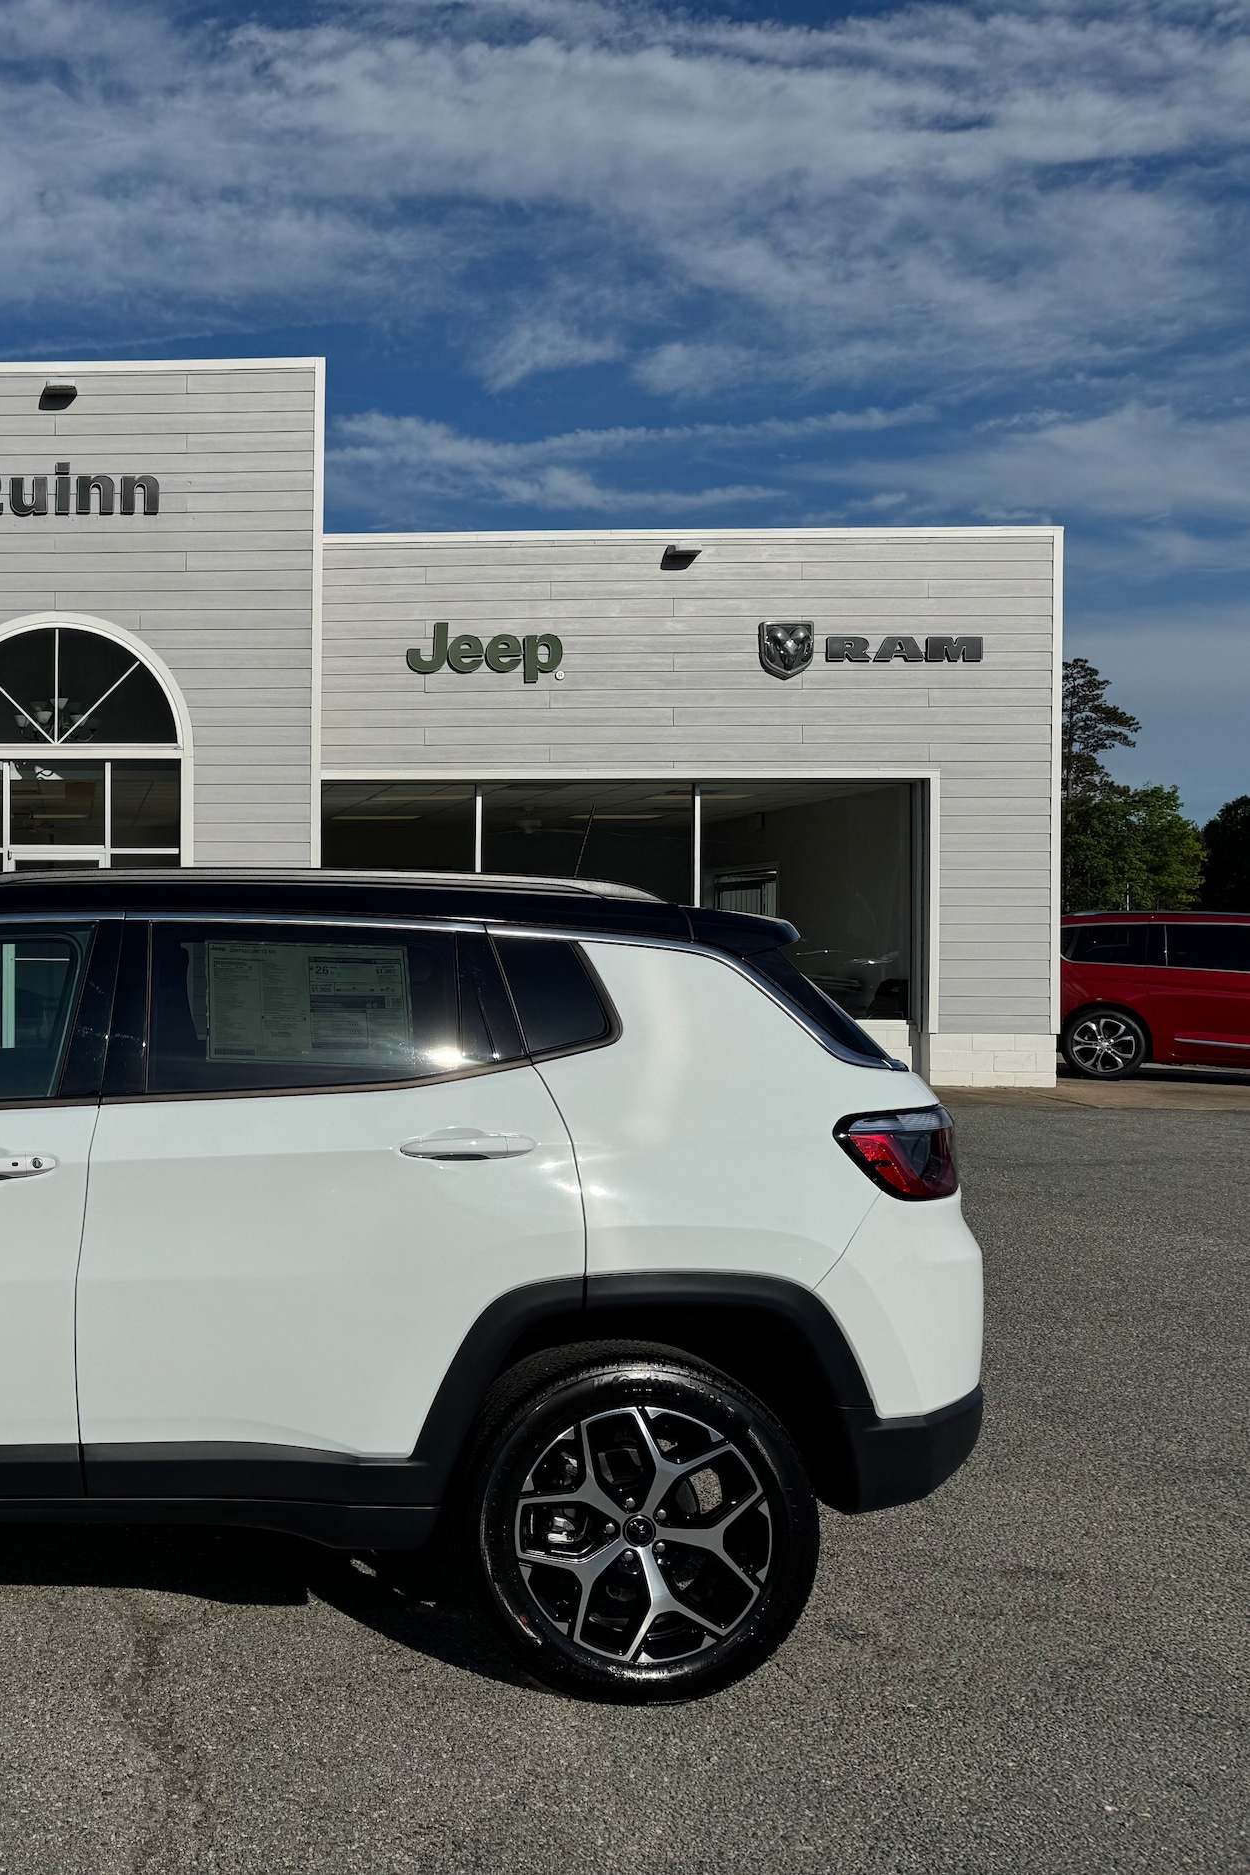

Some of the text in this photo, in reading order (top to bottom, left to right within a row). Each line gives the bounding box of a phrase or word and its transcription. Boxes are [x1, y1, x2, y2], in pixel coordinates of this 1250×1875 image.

[406, 622, 563, 684] Jeep
[825, 636, 984, 662] RAM
[315, 965, 329, 975] 26
